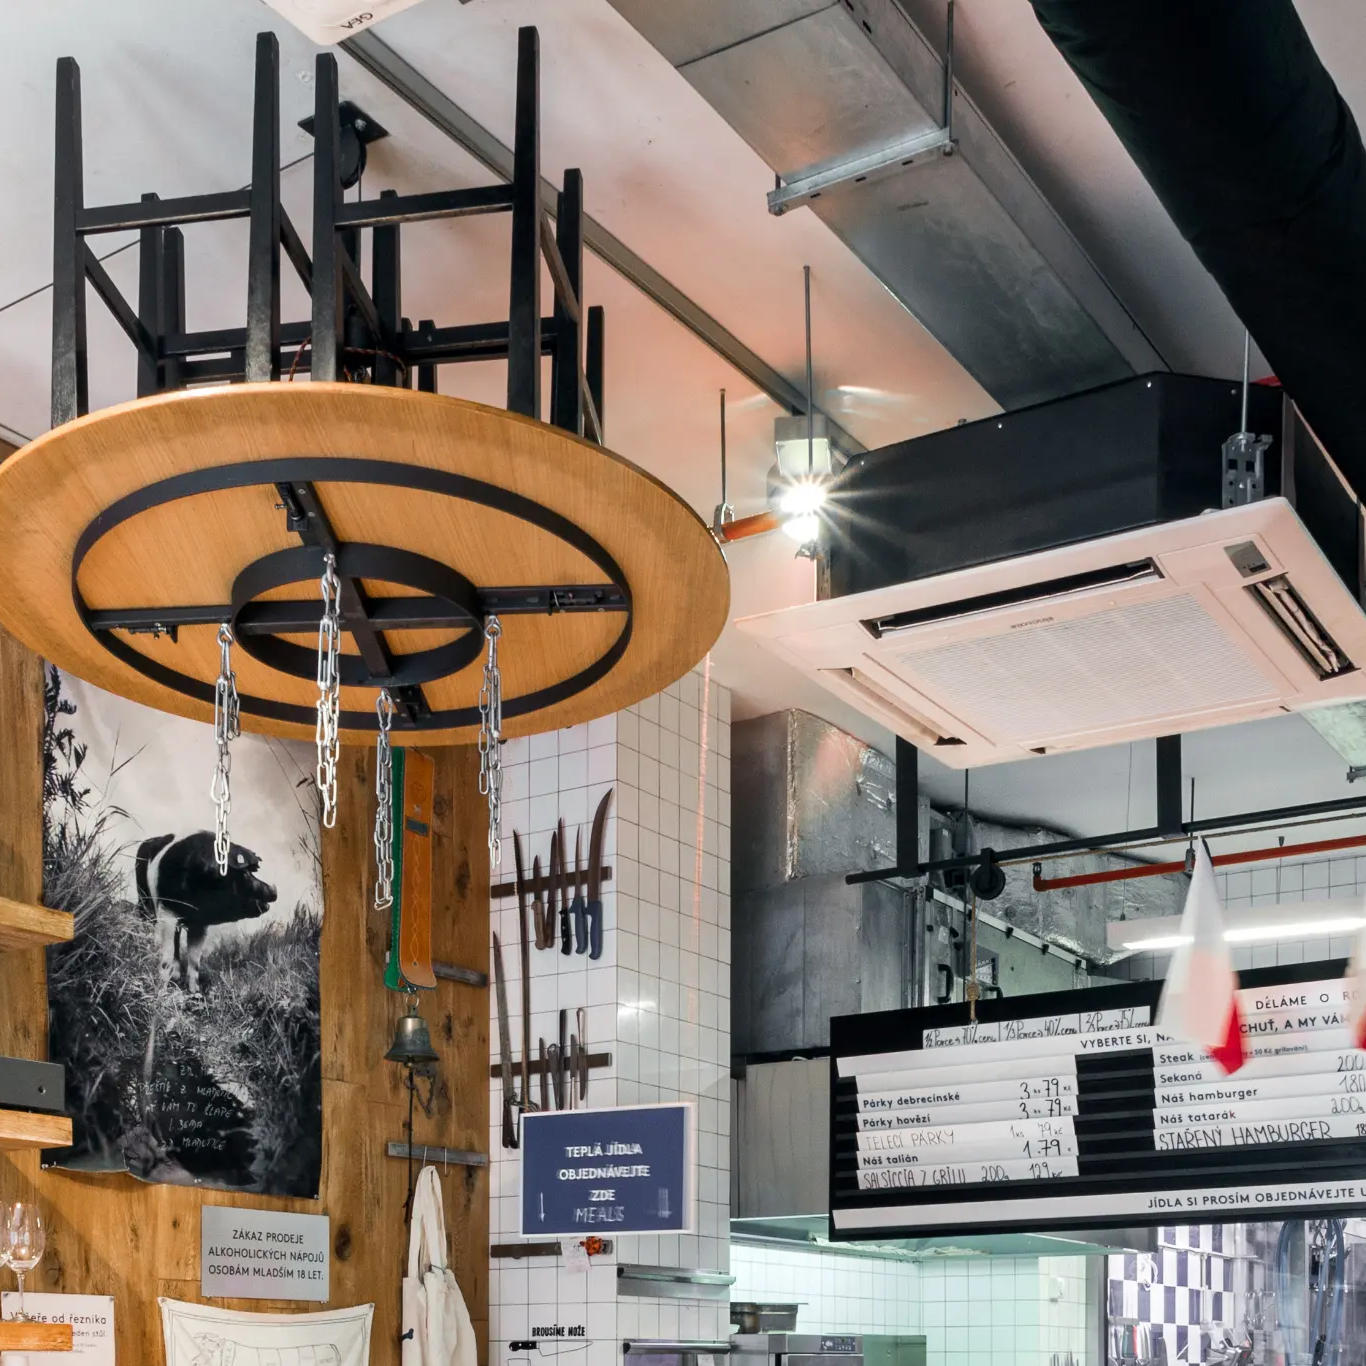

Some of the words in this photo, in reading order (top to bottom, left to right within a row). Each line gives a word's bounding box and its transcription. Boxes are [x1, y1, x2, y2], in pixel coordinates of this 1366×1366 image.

[1319, 993, 1330, 1003] O
[1284, 1019, 1294, 1030] A
[1297, 1016, 1318, 1029] MY
[1081, 1032, 1132, 1048] VYBERTE
[1136, 1032, 1152, 1045] SI,
[1159, 1052, 1194, 1064] Steak
[1160, 1071, 1203, 1083] Sekaná
[863, 1099, 893, 1109] Párky
[897, 1091, 961, 1106] debrecínské
[1019, 1082, 1031, 1100] 3
[1042, 1078, 1060, 1097] 79
[1161, 1093, 1185, 1104] Náš
[1189, 1087, 1258, 1104] hamburger
[863, 1118, 893, 1129] Párky
[897, 1113, 931, 1125] hovězí
[1019, 1102, 1029, 1119] 3
[1046, 1098, 1062, 1117] 79
[1160, 1114, 1184, 1124] Náš
[1188, 1109, 1237, 1123] tatarák
[865, 1133, 904, 1151] TELECÍ
[911, 1129, 955, 1147] PÁRKY
[1231, 1120, 1331, 1145] HAMBURGER
[565, 1142, 603, 1158] TEPLÁ
[863, 1156, 883, 1166] Náš
[886, 1153, 919, 1164] talián
[557, 1164, 650, 1181] OBJEDNÁVEJTE
[589, 1189, 616, 1202] ZDE
[1148, 1196, 1183, 1208] JÍDLA
[1186, 1197, 1198, 1206] SI
[1202, 1192, 1250, 1205] PROSÍM
[1255, 1186, 1355, 1203] OBJEDNÁVEJTE
[232, 1229, 263, 1242] ZÁKAZ
[266, 1231, 304, 1244] PRODEJE
[208, 1246, 287, 1261] ALKOHOLICKÝCH
[290, 1248, 325, 1263] NÁPOJŮ
[208, 1263, 250, 1276] OSOBÁM
[252, 1266, 294, 1279] MLADŠÍM
[297, 1269, 306, 1279] 18
[307, 1269, 324, 1281] LET.
[51, 1314, 66, 1324] od
[69, 1314, 107, 1325] řezníka
[531, 1324, 565, 1337] BROUSÍME
[568, 1324, 586, 1337] NOŽE
